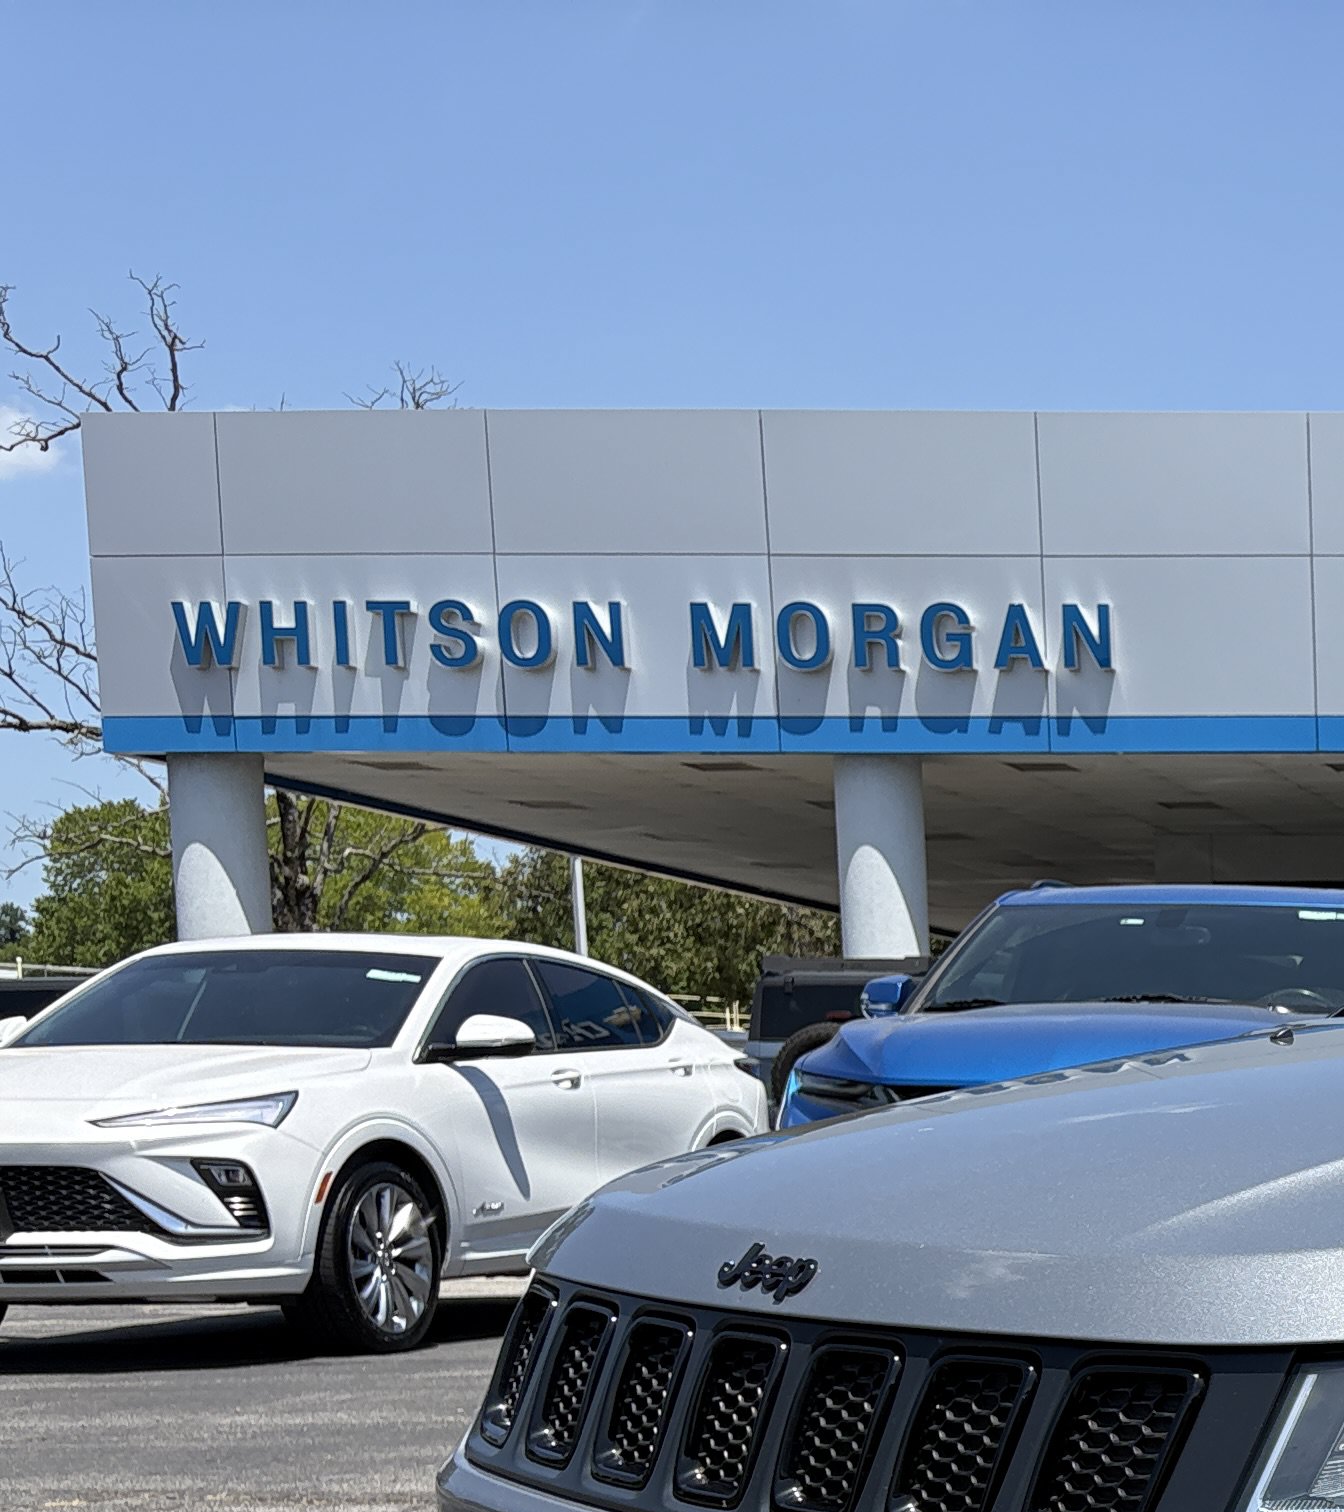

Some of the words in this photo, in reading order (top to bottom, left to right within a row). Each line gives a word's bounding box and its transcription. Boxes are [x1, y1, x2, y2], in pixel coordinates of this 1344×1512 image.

[170, 599, 633, 670] WHITSON
[689, 601, 1116, 671] MORGAN
[716, 1241, 819, 1304] Jeep
